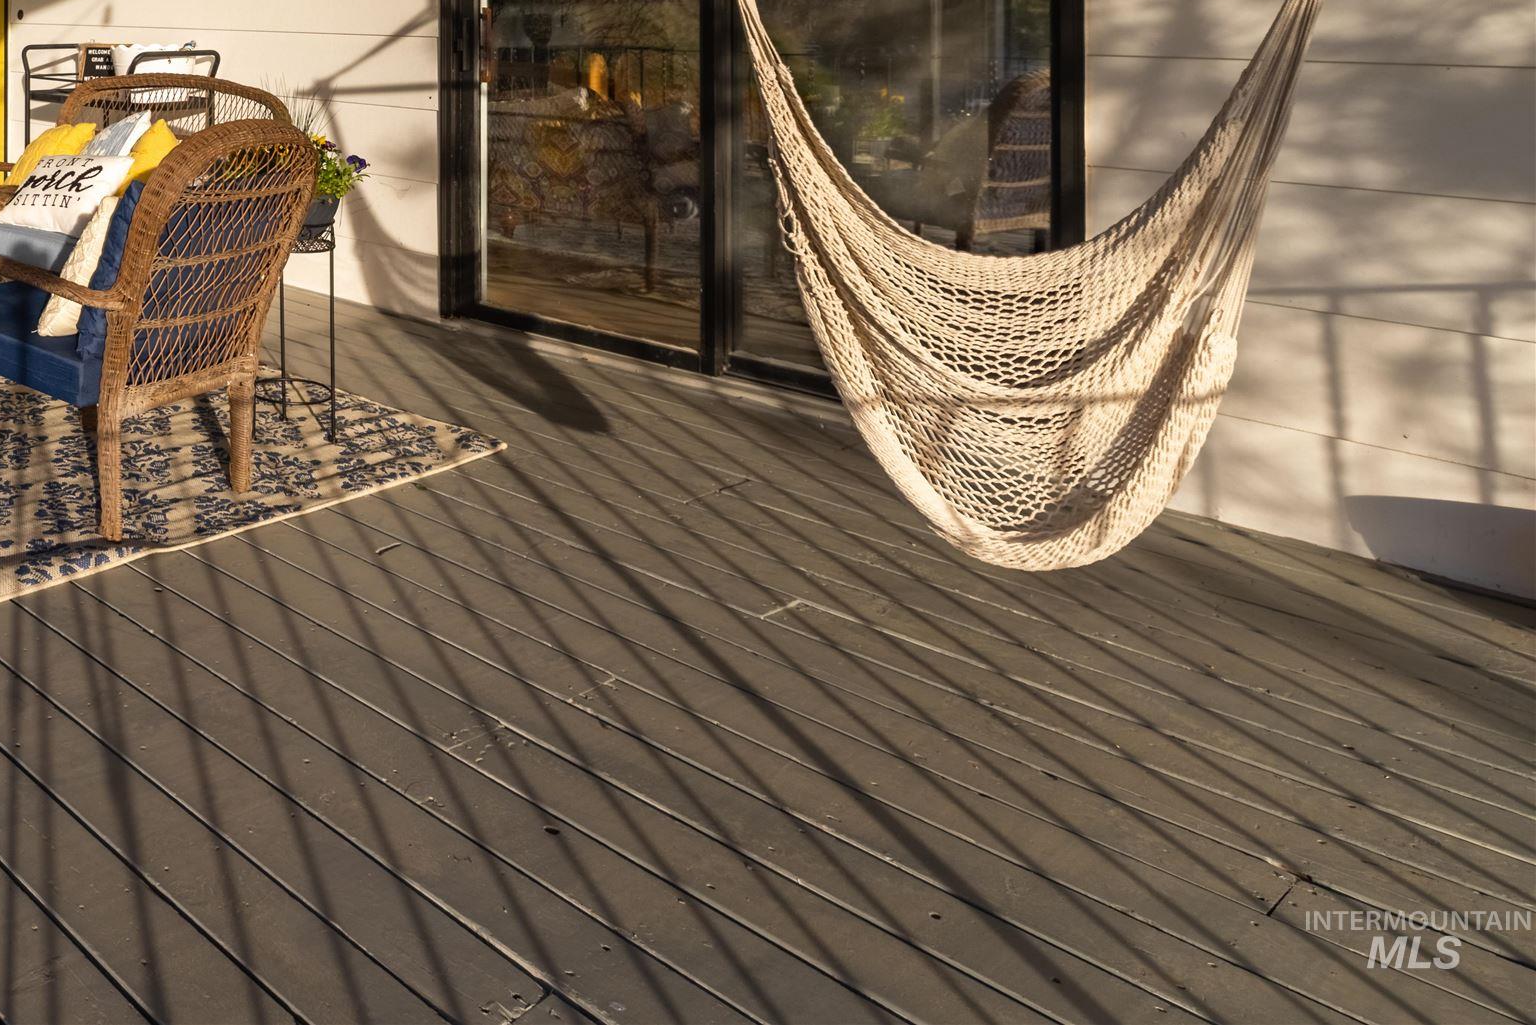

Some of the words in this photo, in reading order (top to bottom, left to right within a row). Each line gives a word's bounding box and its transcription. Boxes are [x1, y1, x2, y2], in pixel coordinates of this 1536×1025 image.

[37, 157, 94, 168] FRONT
[5, 165, 103, 206] porch
[13, 194, 81, 208] SITTIN'
